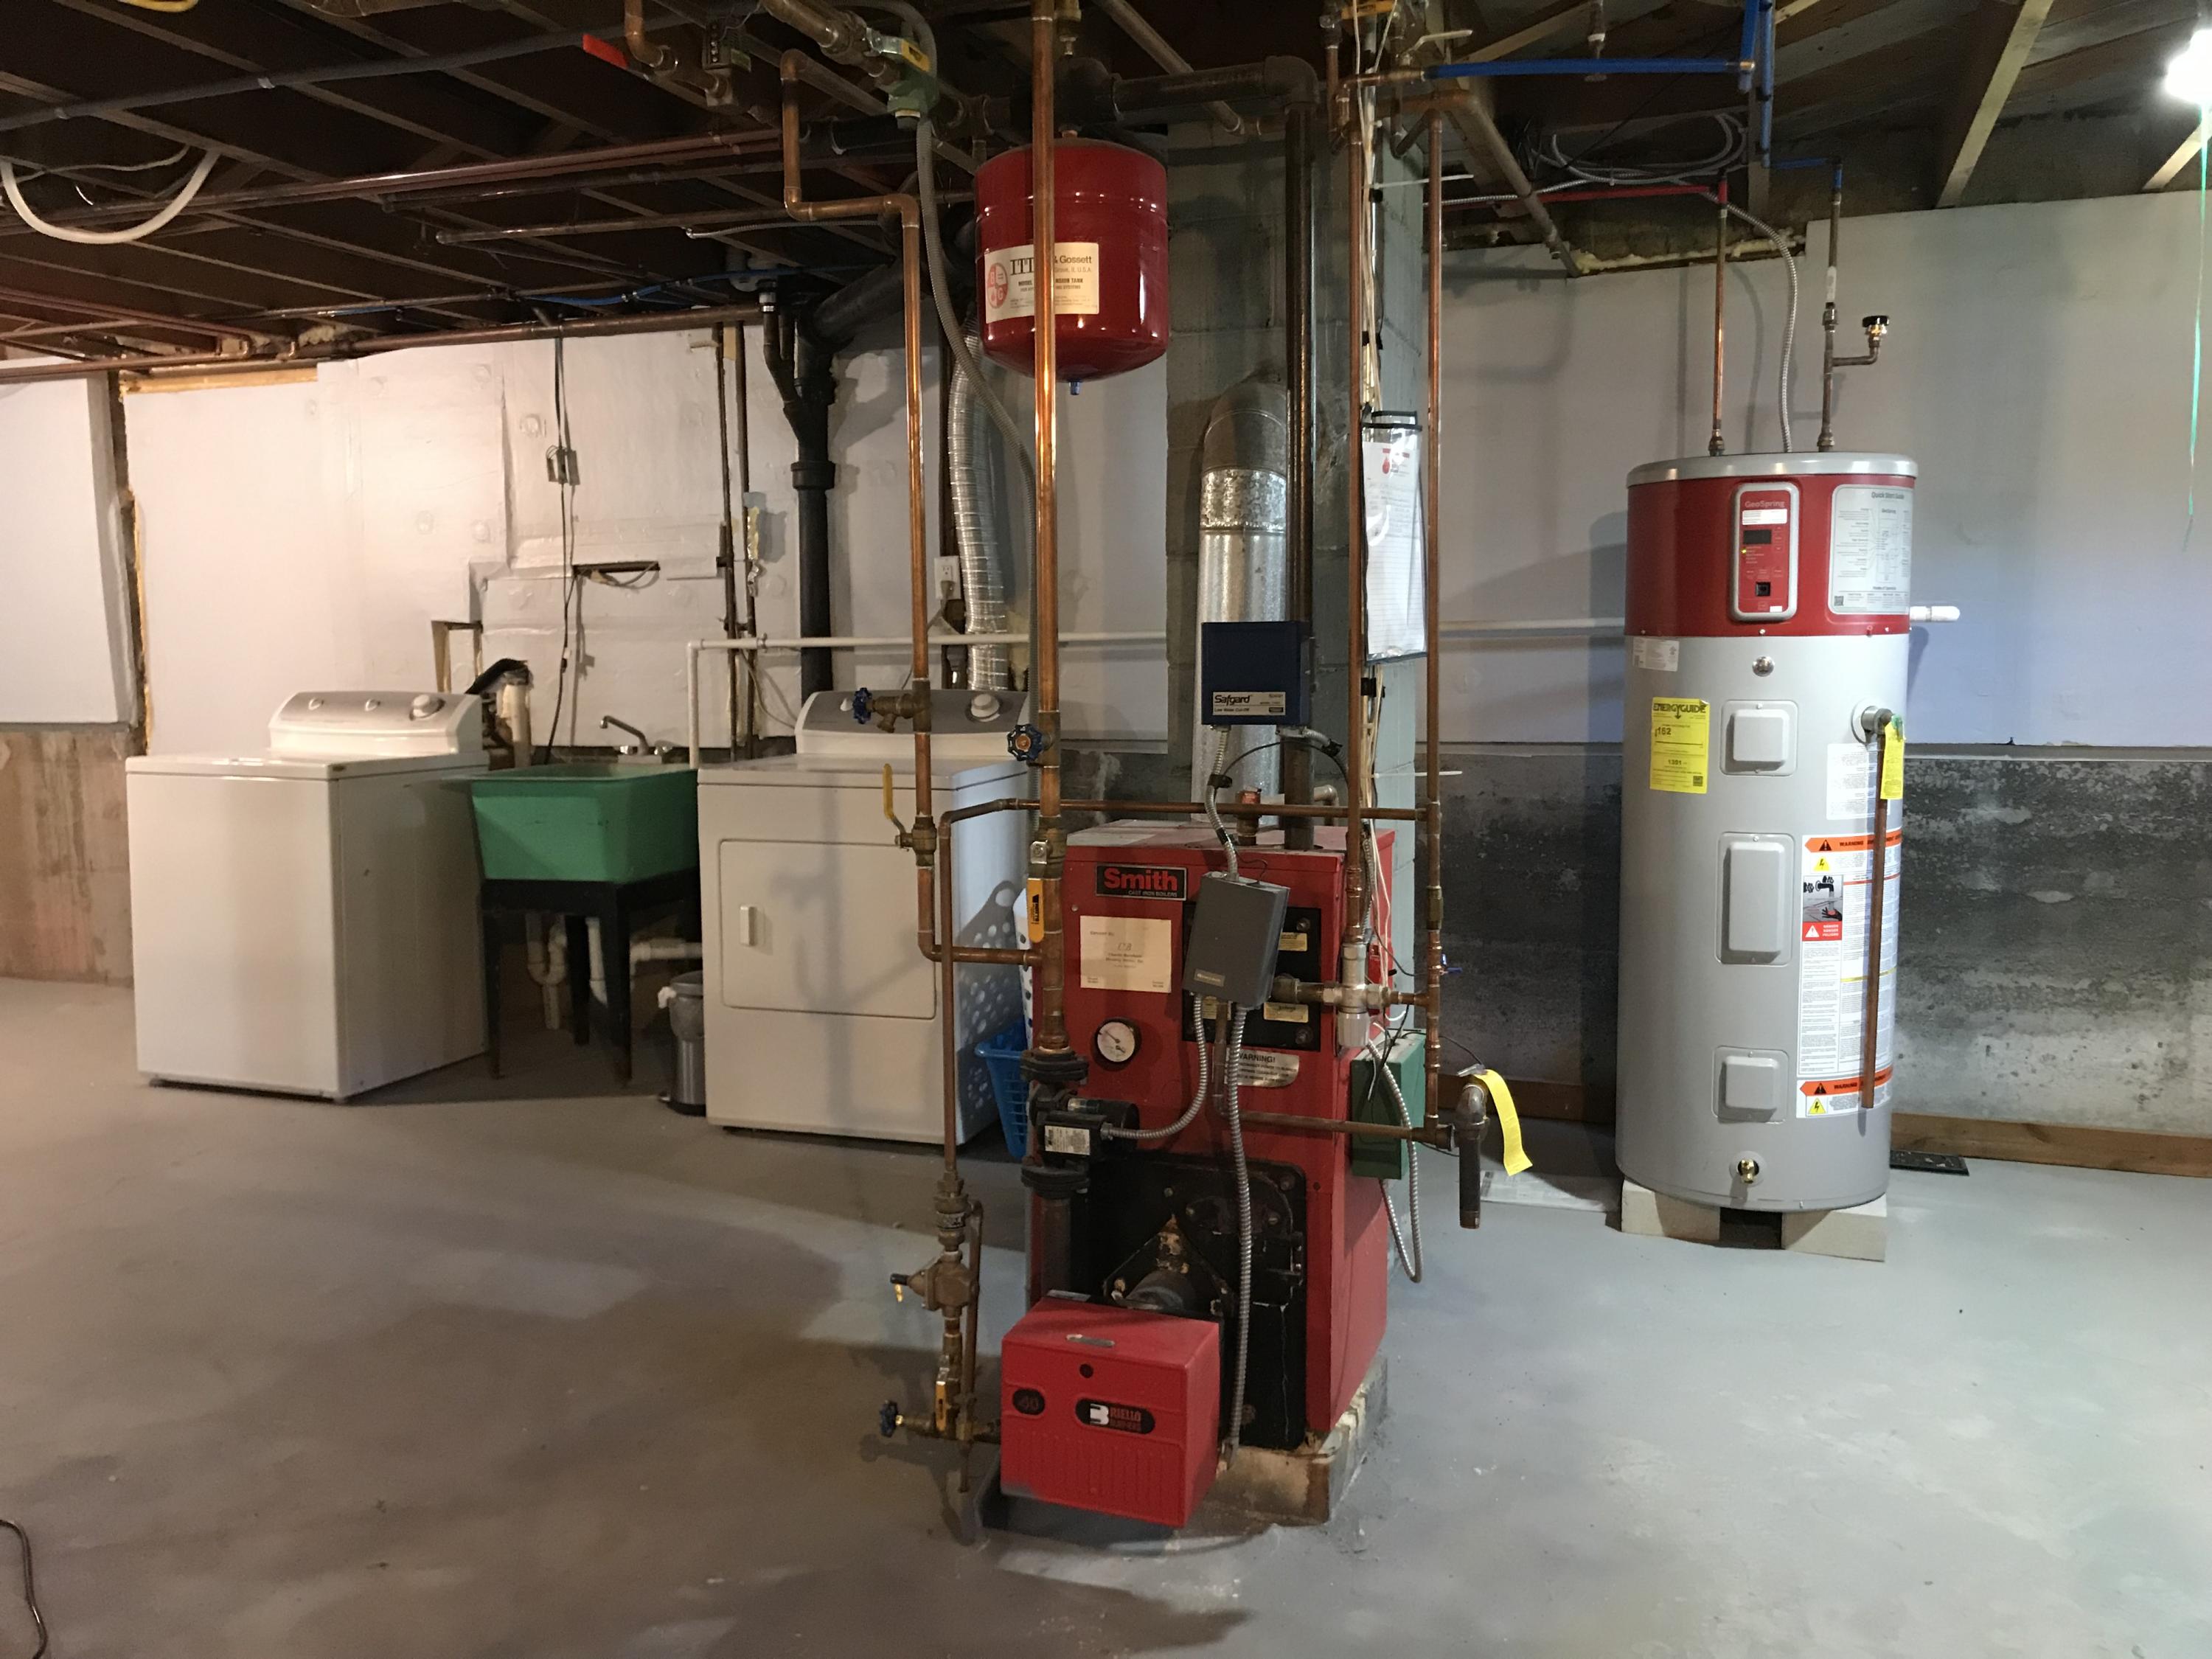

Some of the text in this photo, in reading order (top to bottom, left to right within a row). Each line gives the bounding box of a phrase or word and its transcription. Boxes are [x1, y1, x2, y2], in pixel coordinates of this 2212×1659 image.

[1060, 255, 1092, 264] Gossett
[1009, 257, 1034, 276] ITT
[1745, 500, 1785, 508] GeoSpring
[1214, 695, 1250, 706] Safgard
[1652, 703, 1706, 716] ENERGYGUIDE
[1104, 868, 1178, 891] Smith
[1110, 1407, 1141, 1422] RIELLO
